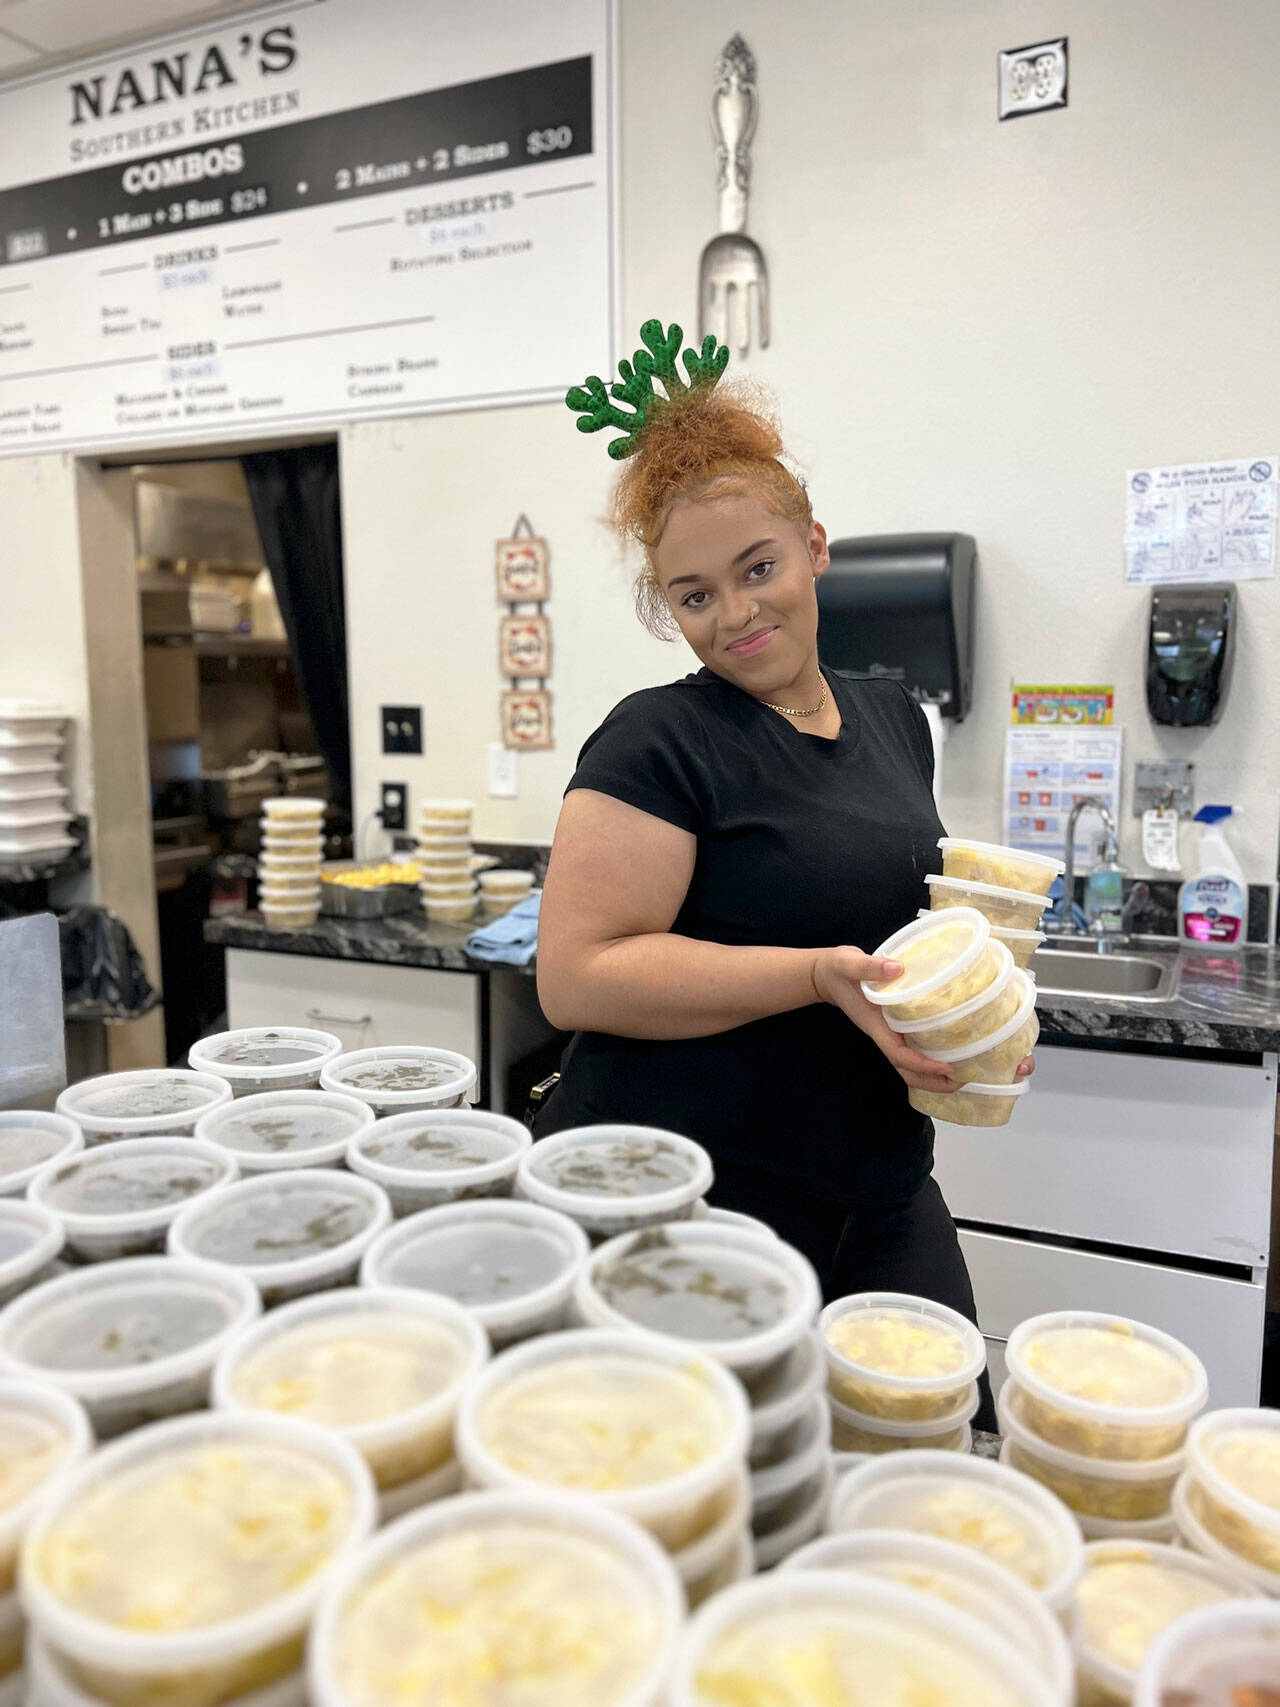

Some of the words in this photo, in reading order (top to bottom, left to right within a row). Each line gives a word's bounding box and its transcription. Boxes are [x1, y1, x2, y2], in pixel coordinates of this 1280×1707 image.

[69, 24, 298, 126] NANA'S
[193, 89, 299, 133] KITCHEN
[122, 144, 244, 195] COMBOS
[335, 169, 351, 190] 2
[432, 149, 449, 171] 2
[527, 125, 573, 156] $30
[405, 190, 515, 226] DESSERTS
